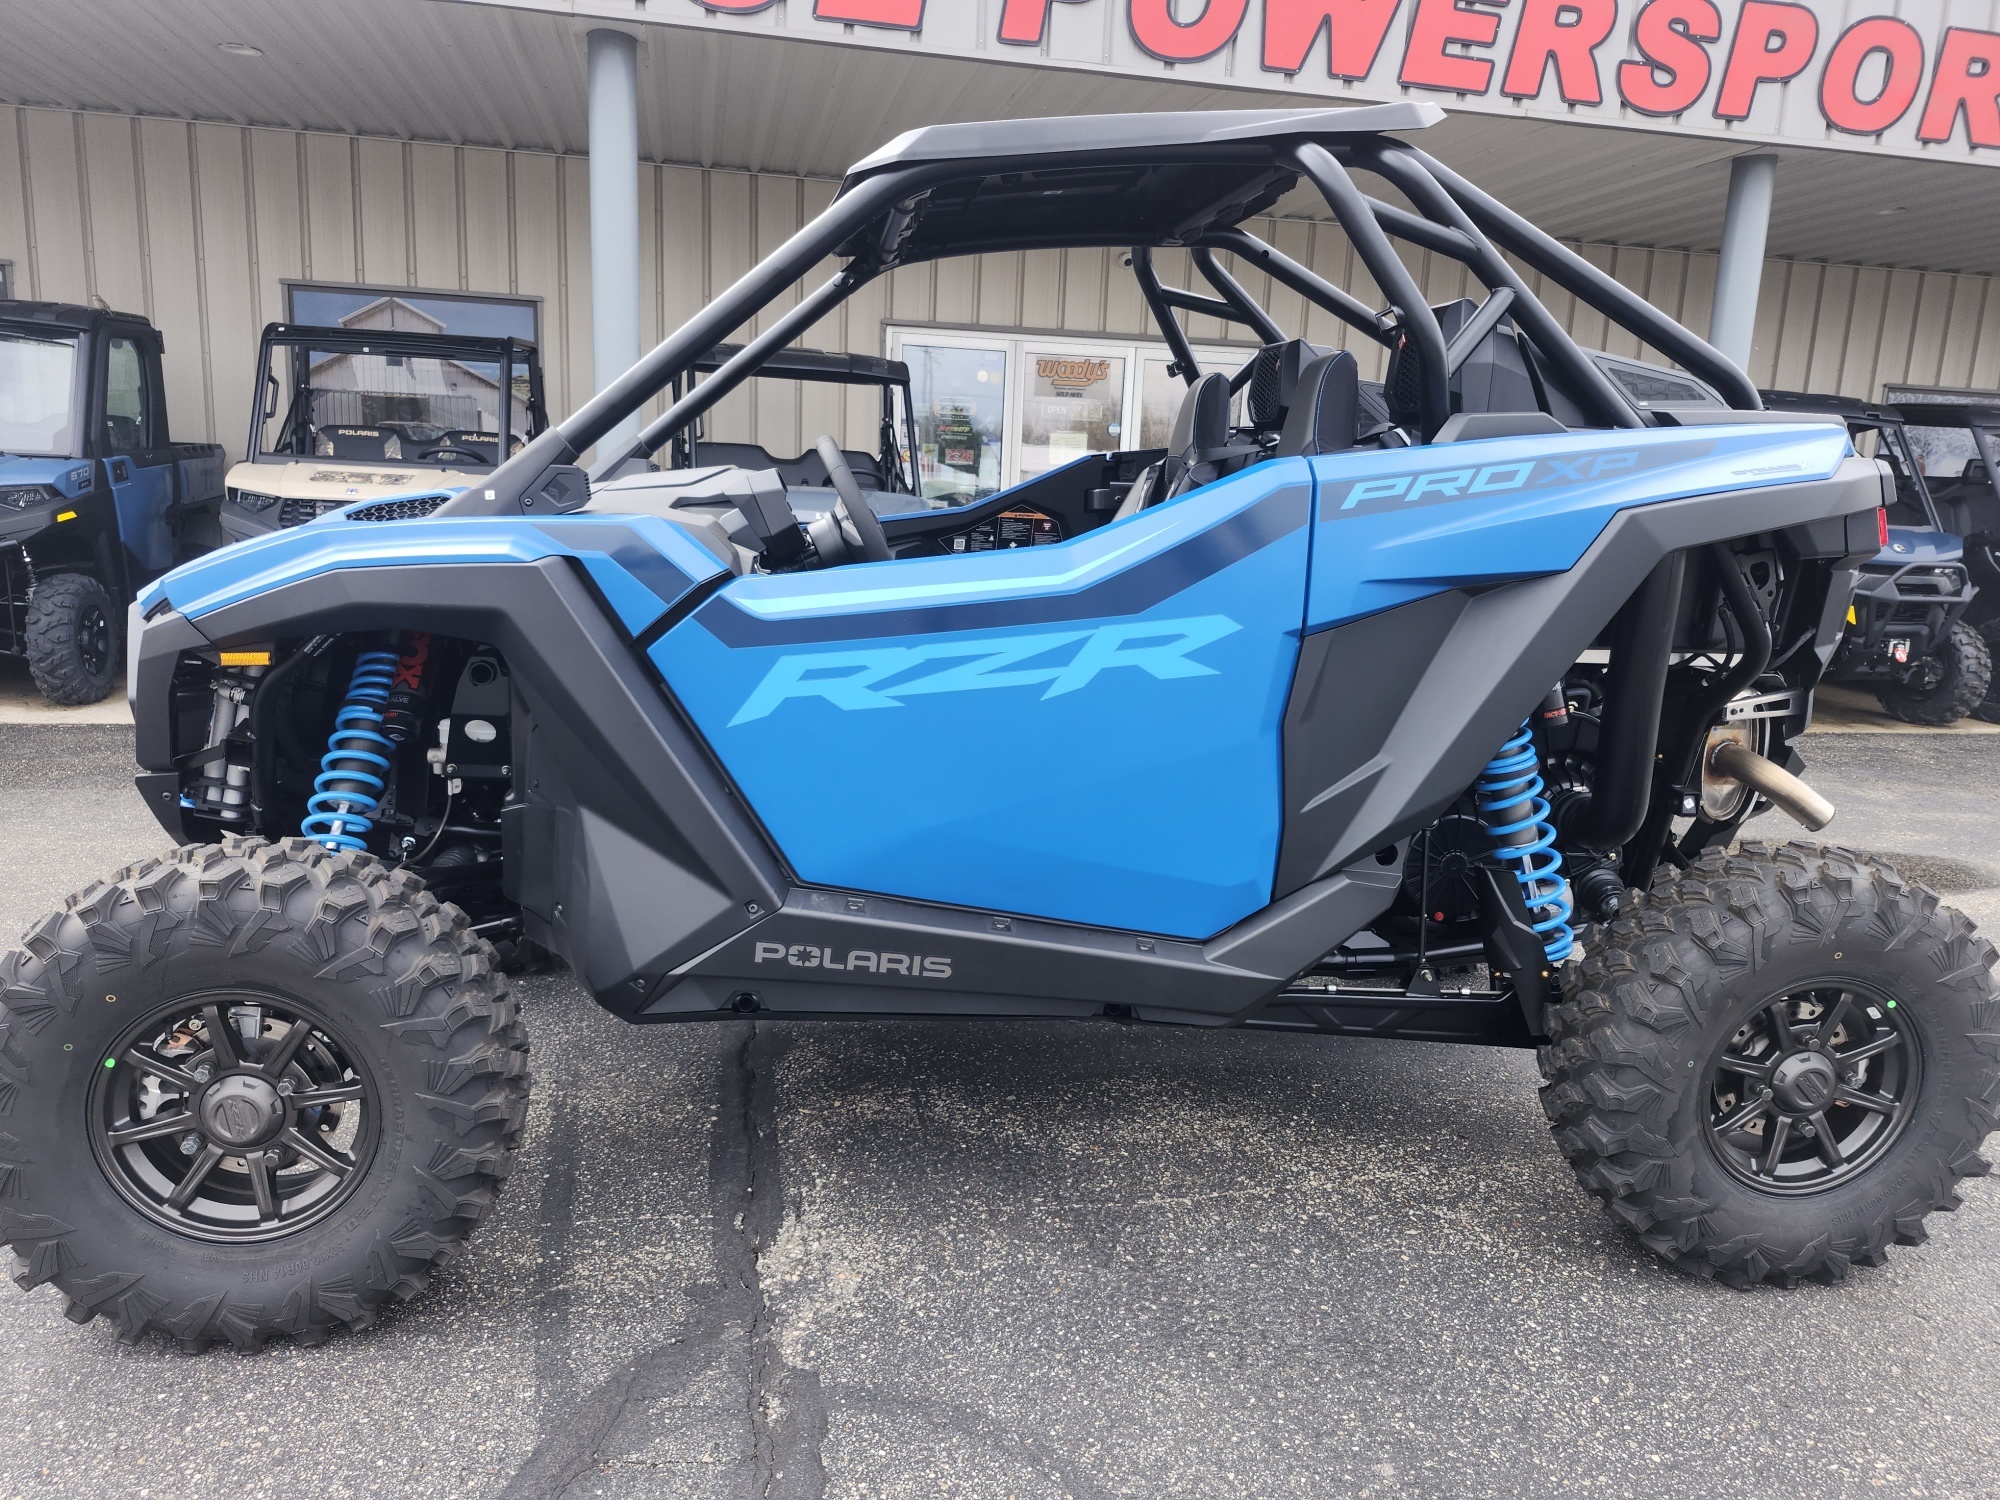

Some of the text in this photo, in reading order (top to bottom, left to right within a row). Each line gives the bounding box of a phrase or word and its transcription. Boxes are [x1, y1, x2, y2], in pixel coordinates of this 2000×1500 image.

[1047, 405, 1067, 415] OPEN
[338, 429, 380, 437] POLARIS
[461, 435, 500, 443] POLARIS
[70, 466, 90, 481] 570
[1340, 451, 1640, 510] PRO XP
[726, 614, 1244, 728] RZR
[387, 696, 410, 704] ALVE
[754, 941, 953, 979] POLARIS
